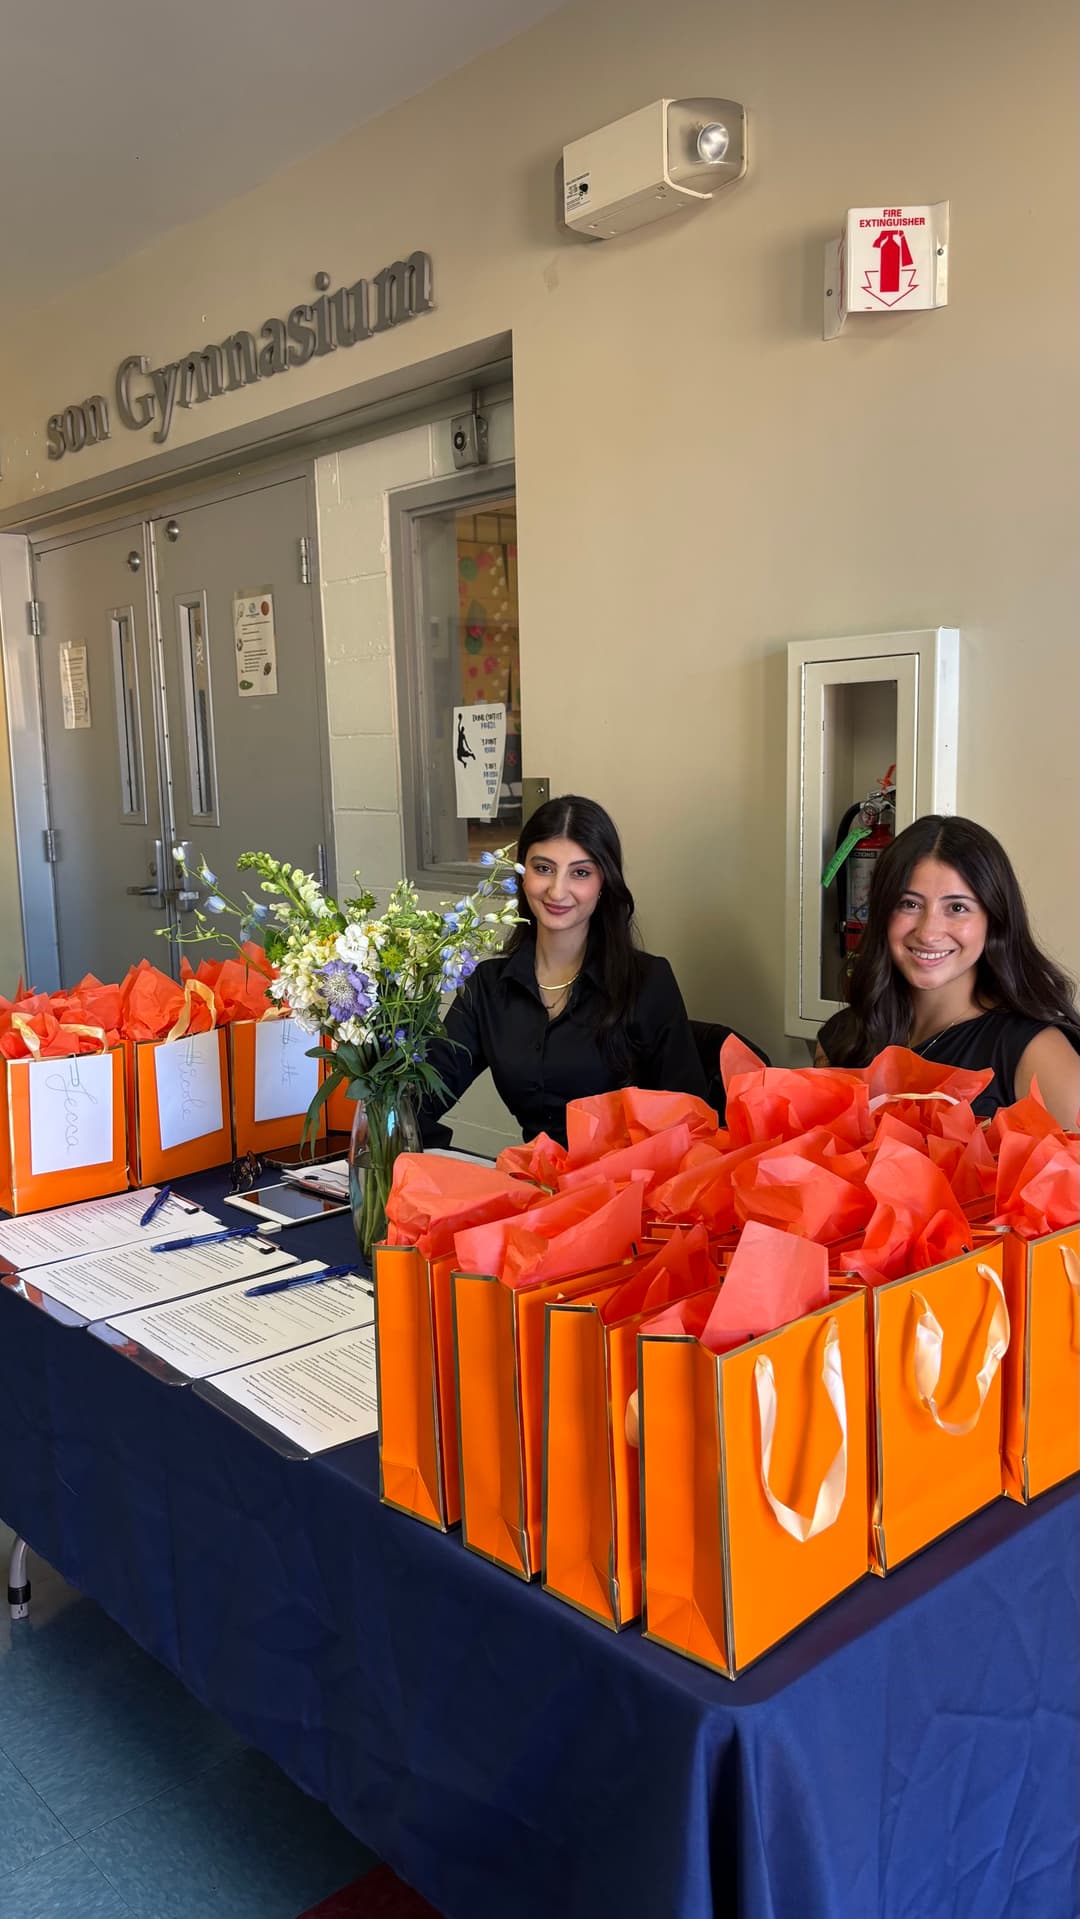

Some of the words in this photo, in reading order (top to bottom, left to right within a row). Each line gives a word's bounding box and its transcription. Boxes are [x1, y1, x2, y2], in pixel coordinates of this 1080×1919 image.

[883, 209, 902, 217] FIRE
[859, 217, 925, 227] EXTINGUISHER
[46, 394, 112, 461] son
[115, 251, 435, 444] Gymnasium
